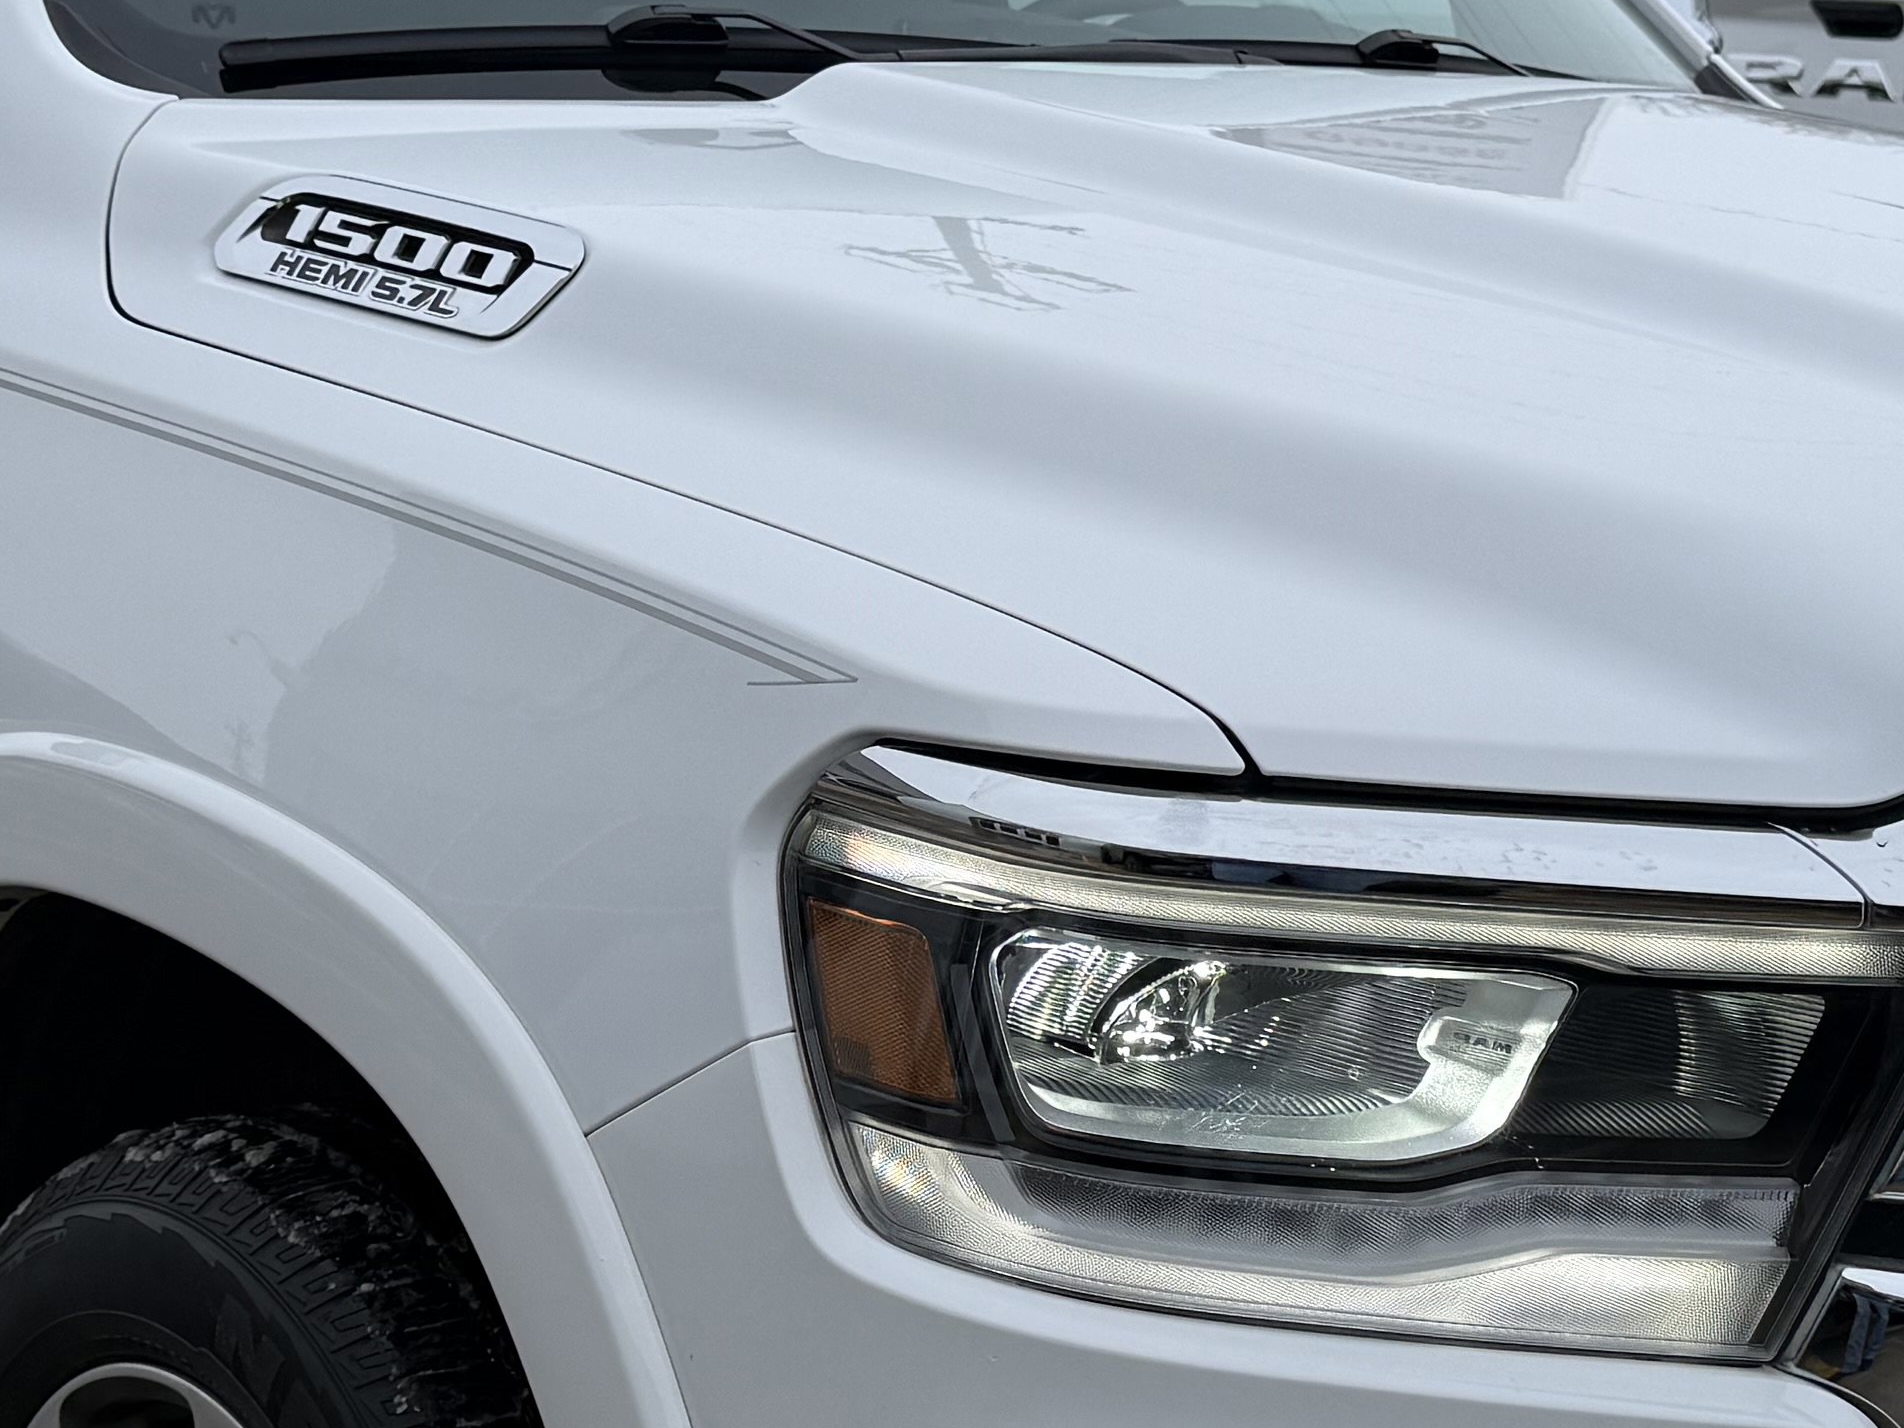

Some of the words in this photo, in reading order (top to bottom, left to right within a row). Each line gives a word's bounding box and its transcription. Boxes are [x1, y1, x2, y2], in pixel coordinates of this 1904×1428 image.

[285, 203, 521, 287] 1500
[269, 251, 370, 294] HEMI
[371, 275, 458, 317] 5.7L
